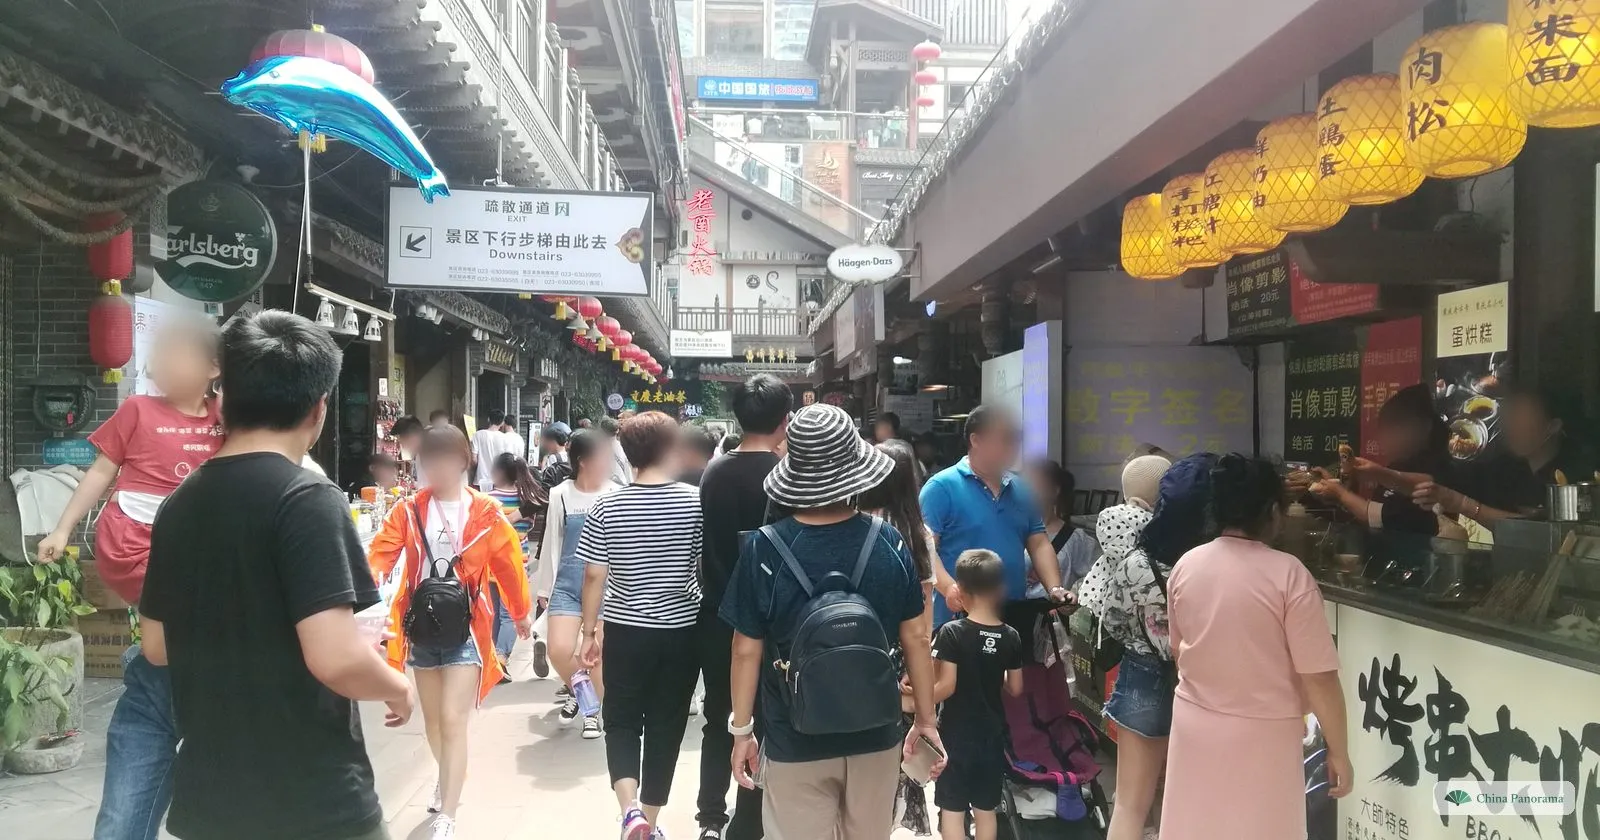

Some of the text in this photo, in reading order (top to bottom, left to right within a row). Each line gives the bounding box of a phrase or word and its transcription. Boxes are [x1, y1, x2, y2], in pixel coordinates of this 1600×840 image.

[1526, 0, 1589, 86] 米面
[1405, 47, 1450, 142] 肉松
[484, 199, 551, 216] 疏散通道
[507, 215, 527, 223] EXIT
[445, 228, 608, 251] 景区下行步梯由此去
[489, 248, 563, 262] Downstairs
[1226, 265, 1287, 297] 肖像剪影
[1451, 322, 1494, 349] 蛋烘糕
[1289, 385, 1358, 419] 肖像剪影
[1292, 435, 1314, 452] 绝活
